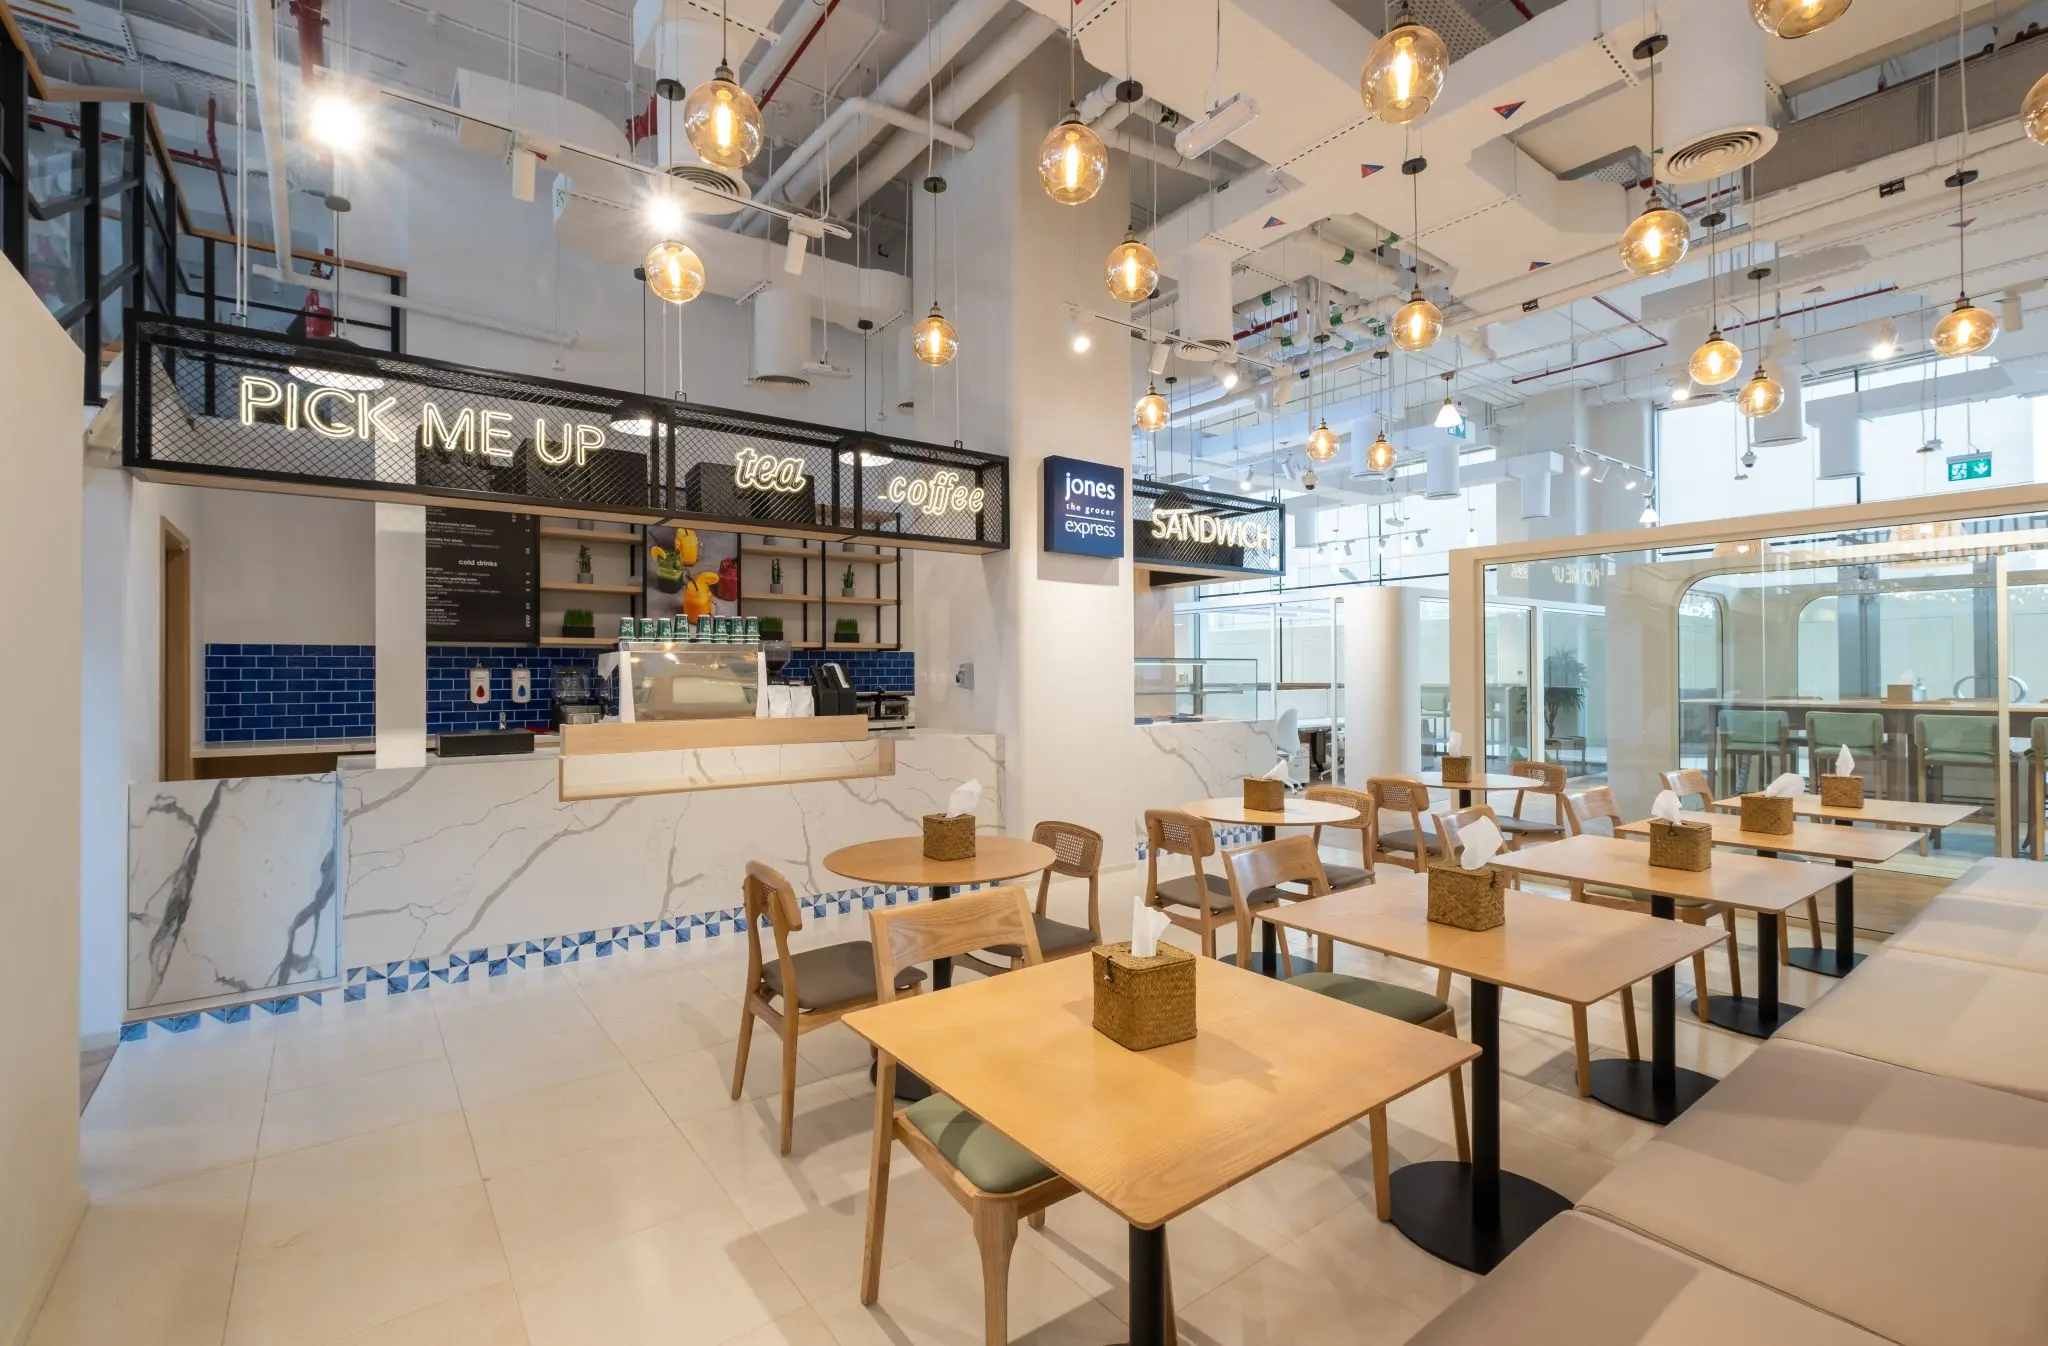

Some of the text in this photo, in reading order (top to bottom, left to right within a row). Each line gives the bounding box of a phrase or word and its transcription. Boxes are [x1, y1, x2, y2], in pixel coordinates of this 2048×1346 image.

[240, 375, 605, 466] PICK ME UP
[735, 447, 806, 492] tea
[1064, 472, 1116, 501] jones
[888, 470, 984, 515] coffee
[1066, 502, 1116, 516] the grocer
[1064, 520, 1116, 539] express
[1151, 508, 1271, 549] SANDWICH
